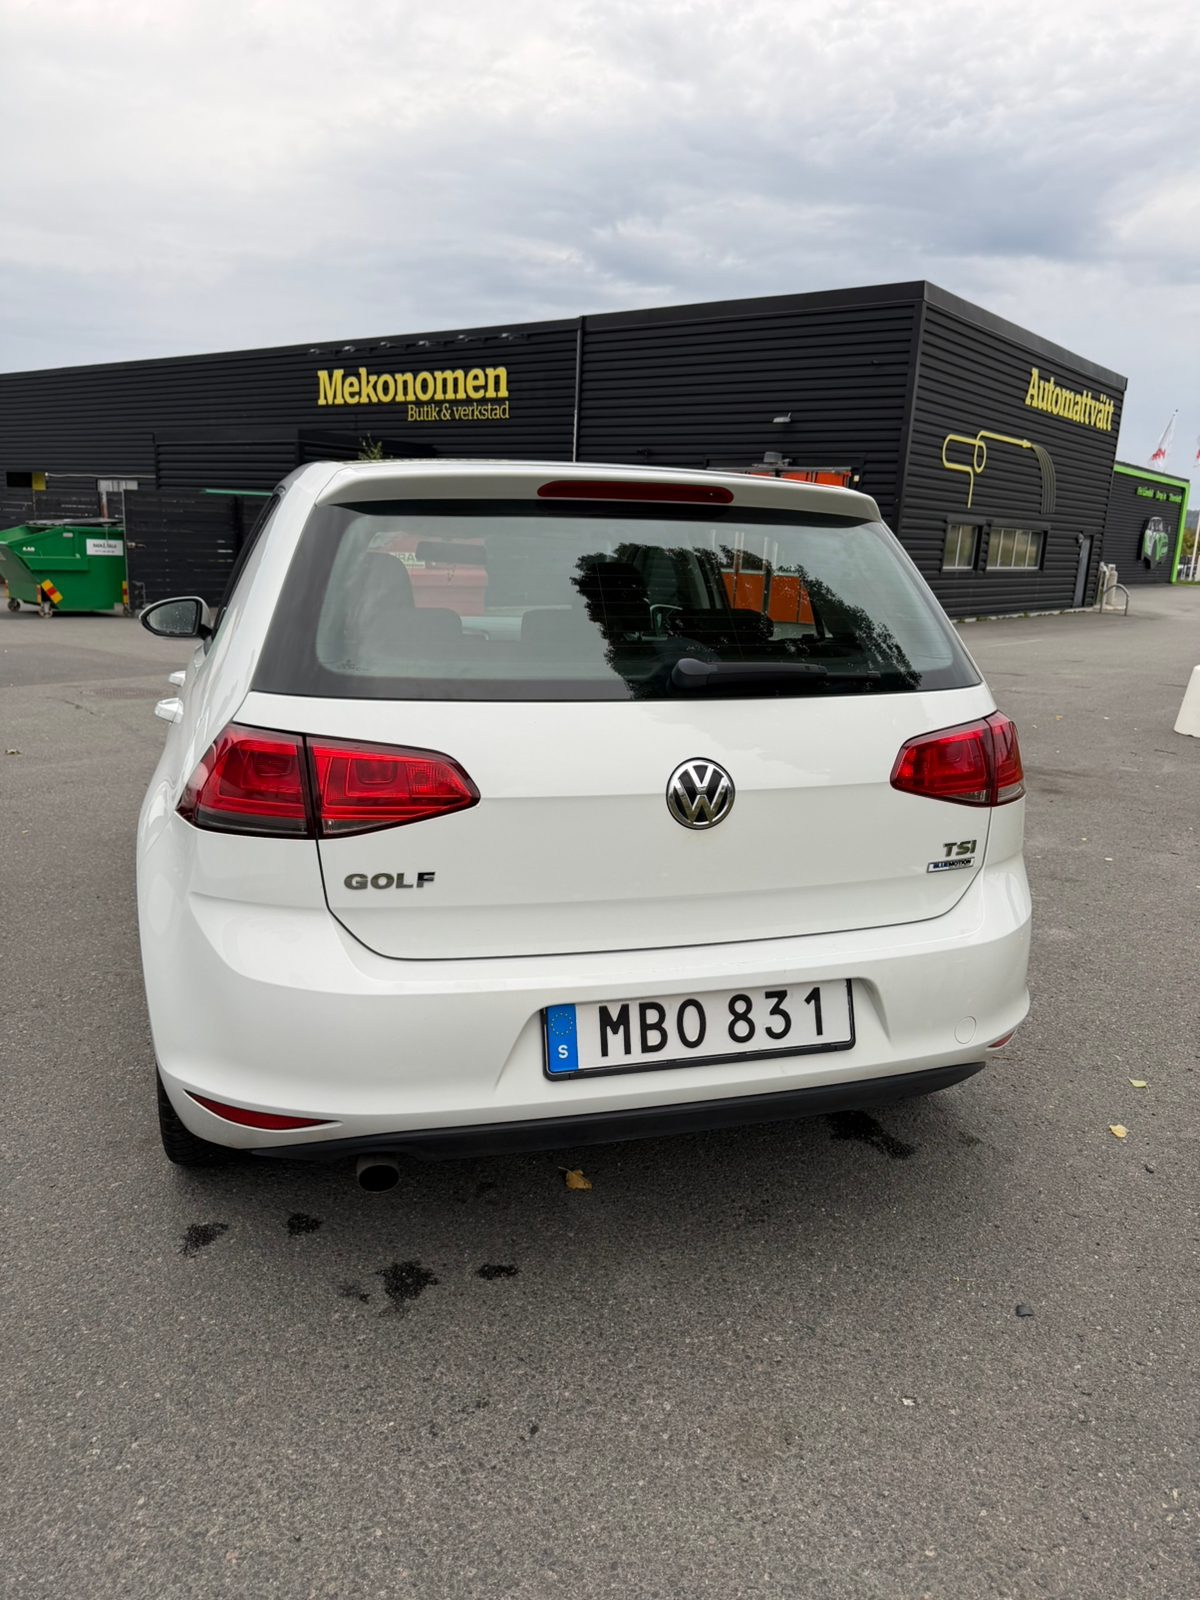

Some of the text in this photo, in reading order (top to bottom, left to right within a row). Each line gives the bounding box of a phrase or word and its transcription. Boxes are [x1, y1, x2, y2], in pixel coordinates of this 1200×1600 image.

[317, 366, 509, 406] Mekonomen
[1025, 367, 1114, 432] Automattvätt
[407, 401, 509, 421] Butik & verkstad
[943, 839, 978, 857] TSI
[344, 871, 436, 890] GOLF
[598, 986, 824, 1057] MBO 831
[557, 1044, 569, 1060] S
